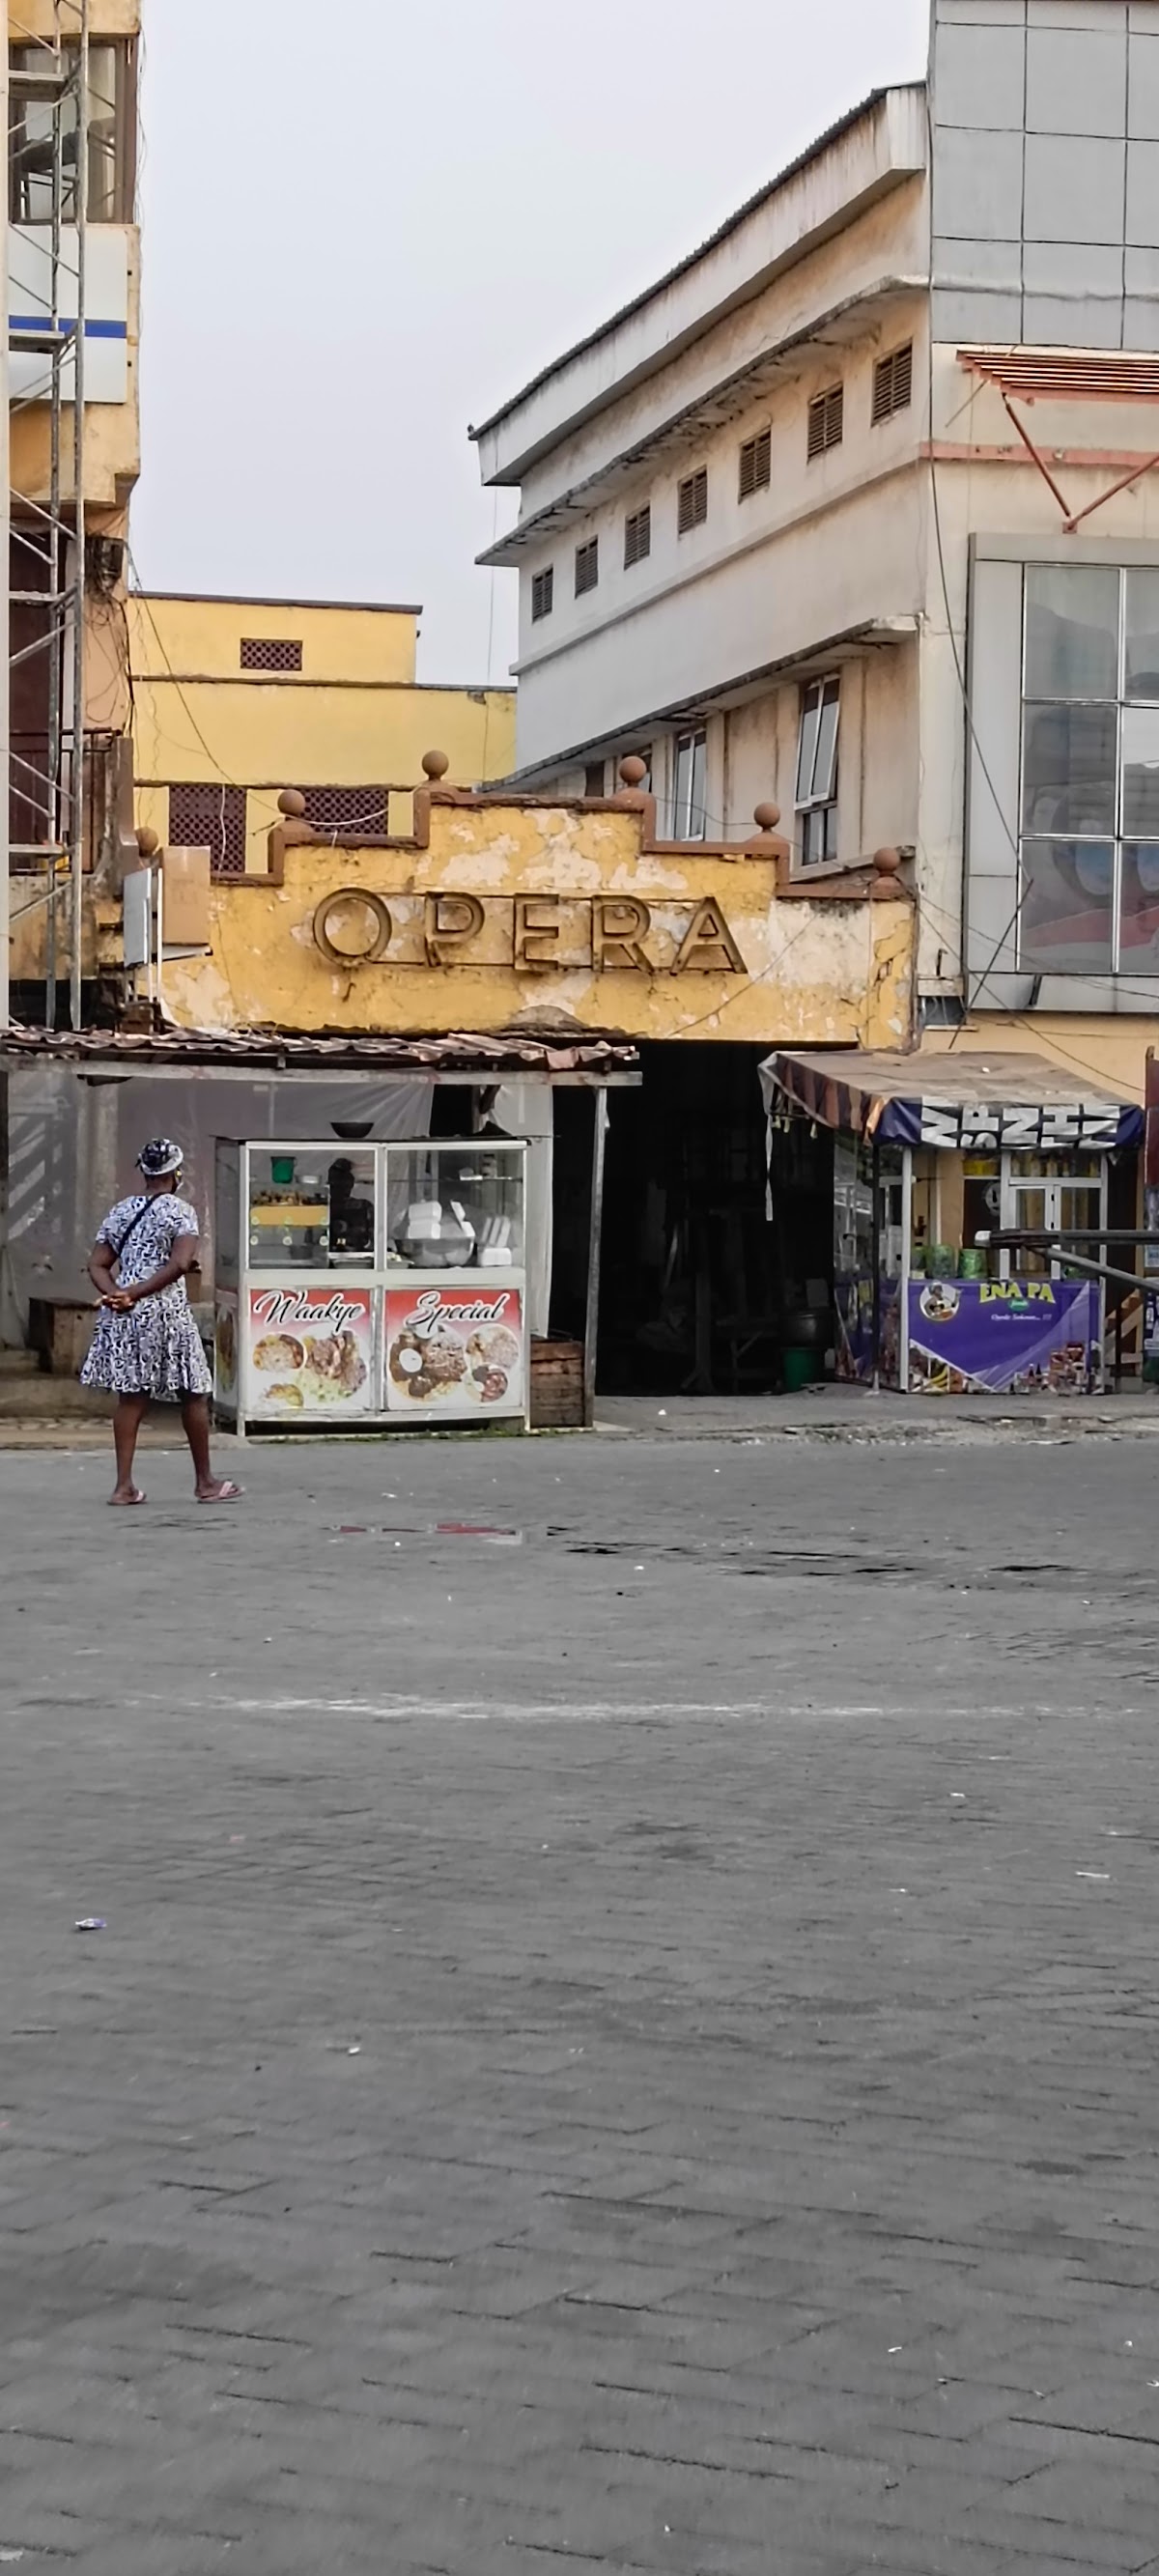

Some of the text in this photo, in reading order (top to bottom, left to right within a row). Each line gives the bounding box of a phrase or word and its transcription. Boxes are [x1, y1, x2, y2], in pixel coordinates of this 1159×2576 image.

[312, 887, 748, 975] OPERA
[254, 1289, 510, 1335] Waakye Special
[979, 1282, 1056, 1304] ENA PA
